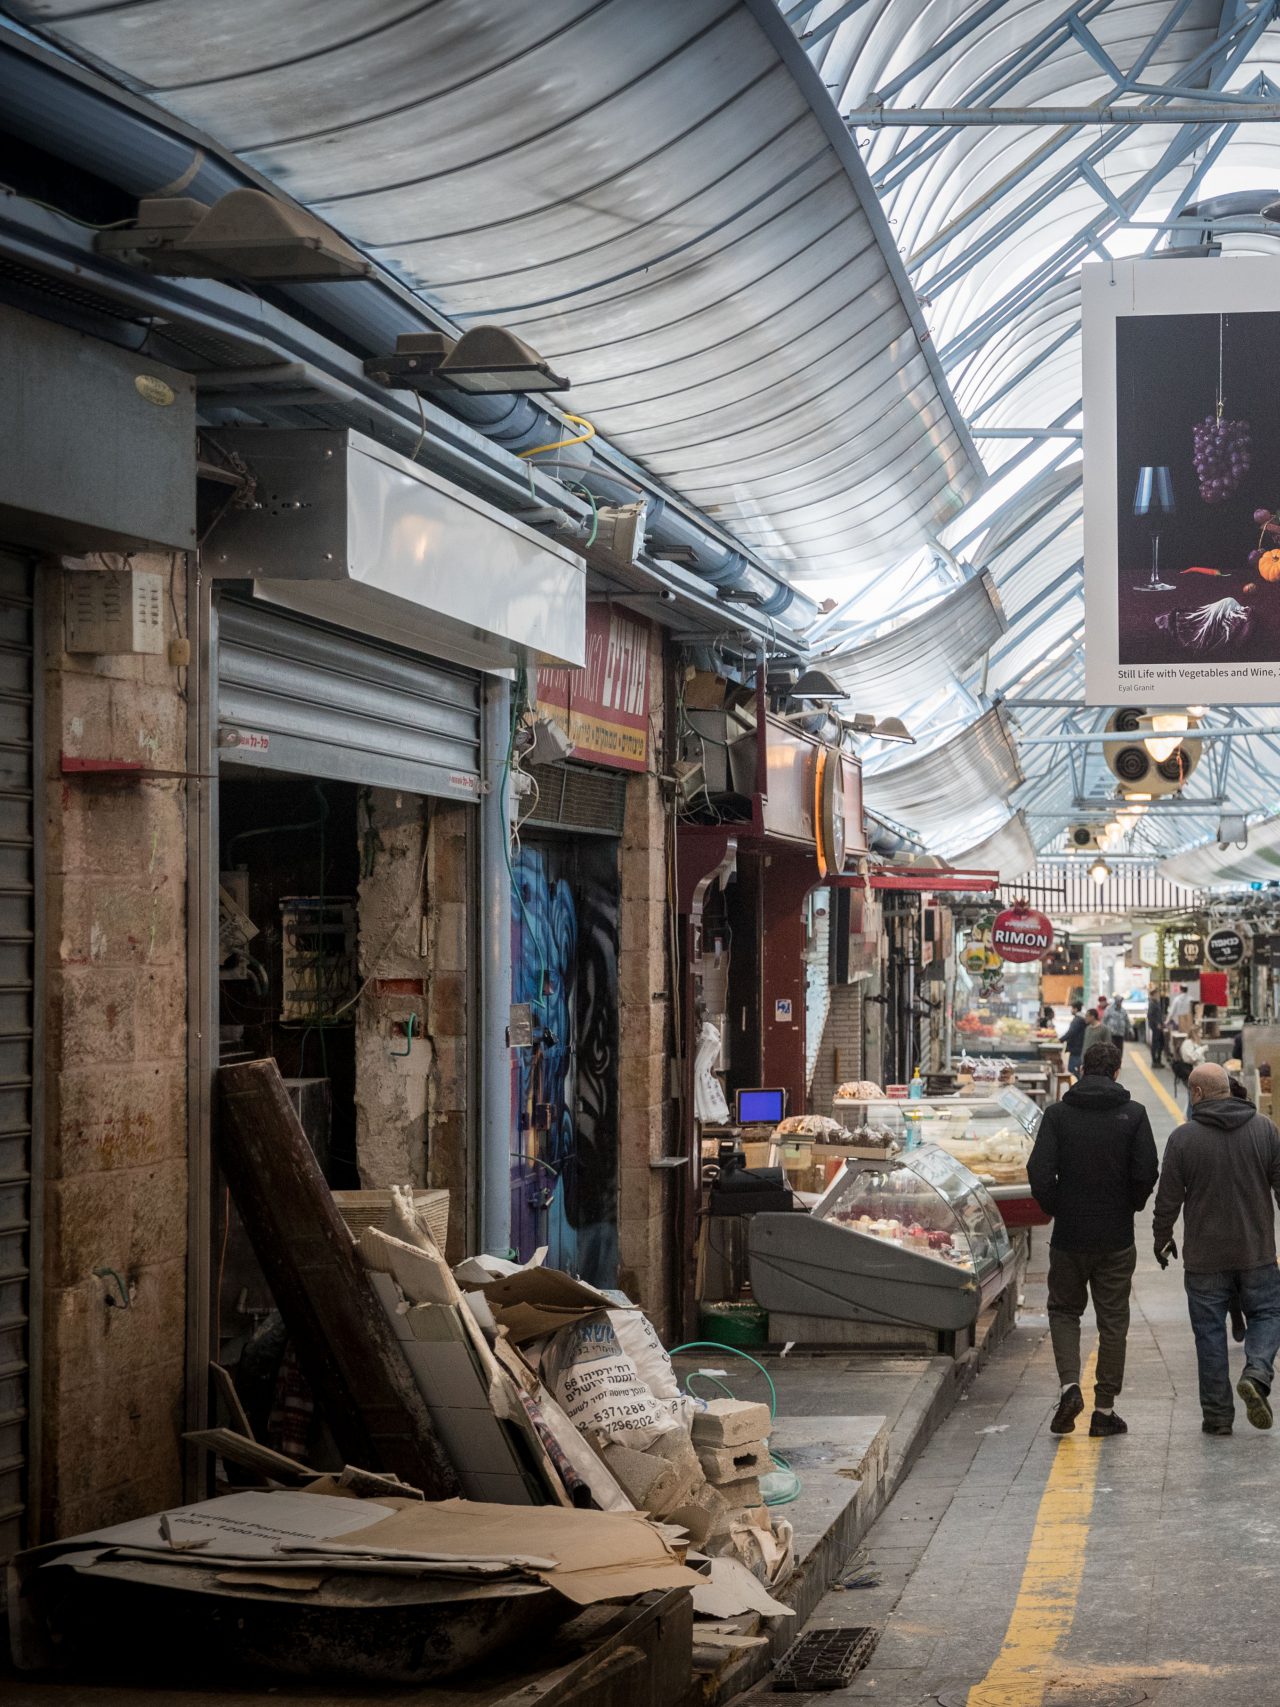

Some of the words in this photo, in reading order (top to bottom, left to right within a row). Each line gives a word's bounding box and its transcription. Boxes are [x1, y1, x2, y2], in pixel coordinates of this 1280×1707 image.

[1118, 669, 1136, 679] Still
[1138, 669, 1155, 678] Life
[1157, 669, 1177, 678] with
[1179, 668, 1229, 680] Vegetables
[1231, 668, 1248, 677] and
[1250, 667, 1276, 678] Wine,
[1118, 684, 1133, 693] Eyal
[1134, 684, 1155, 692] Granit
[995, 930, 1048, 947] RIMON
[580, 1366, 613, 1384] ירמיהו
[564, 1377, 578, 1391] 66
[565, 1378, 605, 1403] ירושלים
